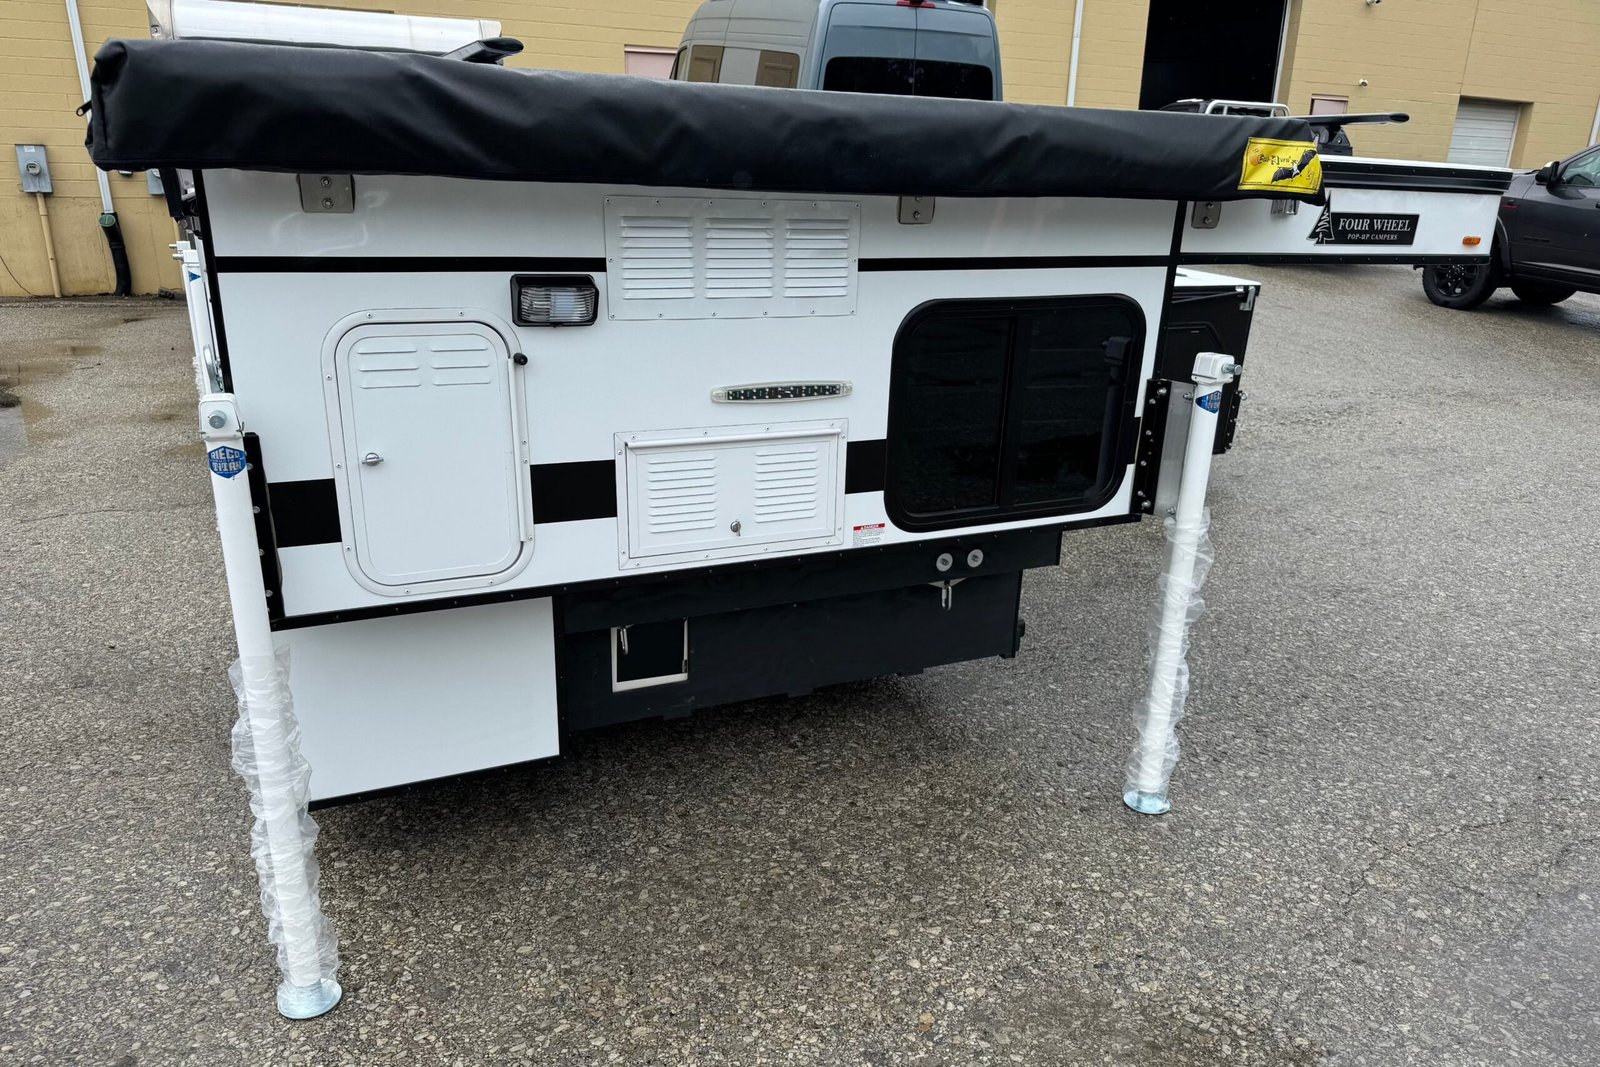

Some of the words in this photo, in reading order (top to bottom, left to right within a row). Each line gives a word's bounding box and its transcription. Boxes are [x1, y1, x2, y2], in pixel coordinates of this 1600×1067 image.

[1338, 218, 1369, 230] FOUR
[1373, 219, 1411, 231] WHEEL
[211, 461, 242, 472] TITAN
